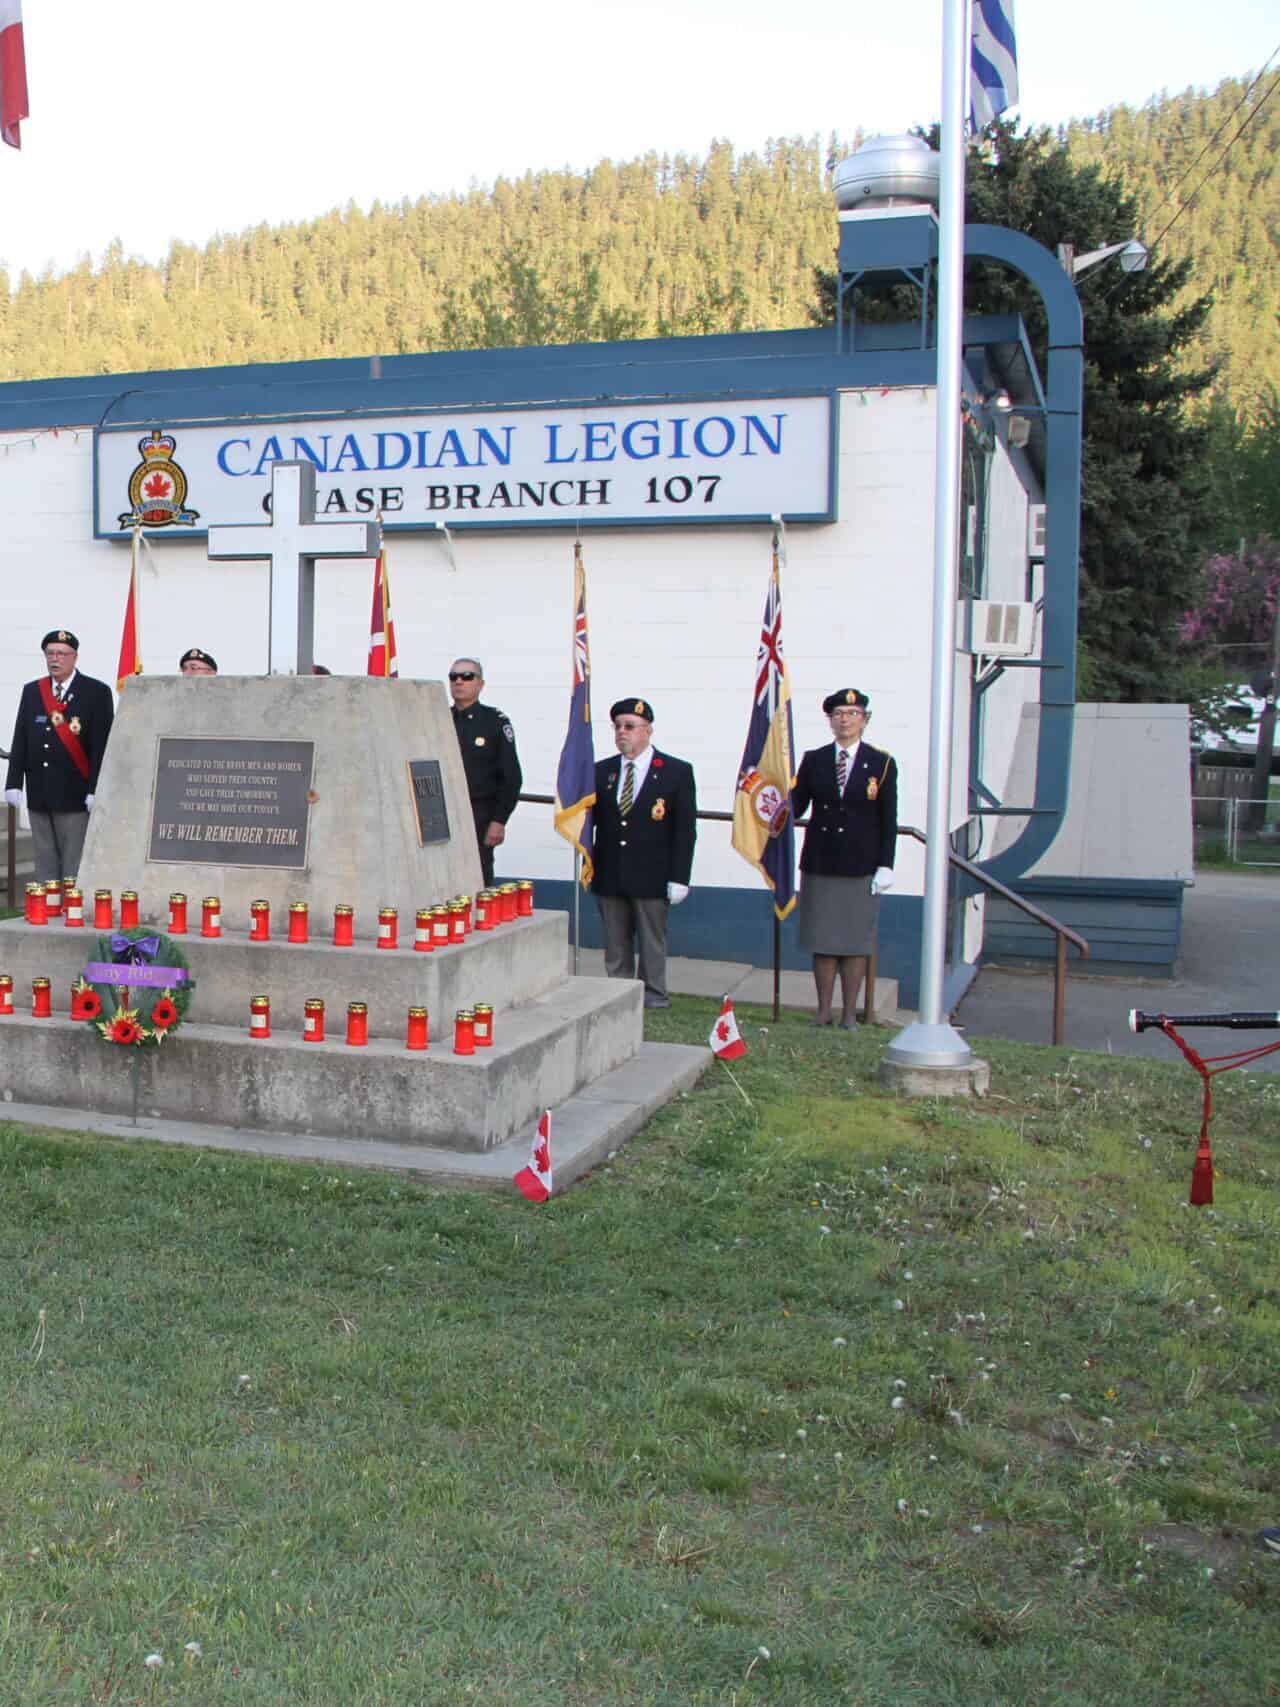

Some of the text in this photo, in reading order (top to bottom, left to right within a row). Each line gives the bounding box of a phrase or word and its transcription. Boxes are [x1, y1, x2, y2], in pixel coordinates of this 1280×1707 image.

[216, 414, 788, 477] CANADIAN LEGION
[262, 475, 722, 516] ASE BRANCH 107
[159, 823, 299, 847] WE WILL REMEMBER THEM.
